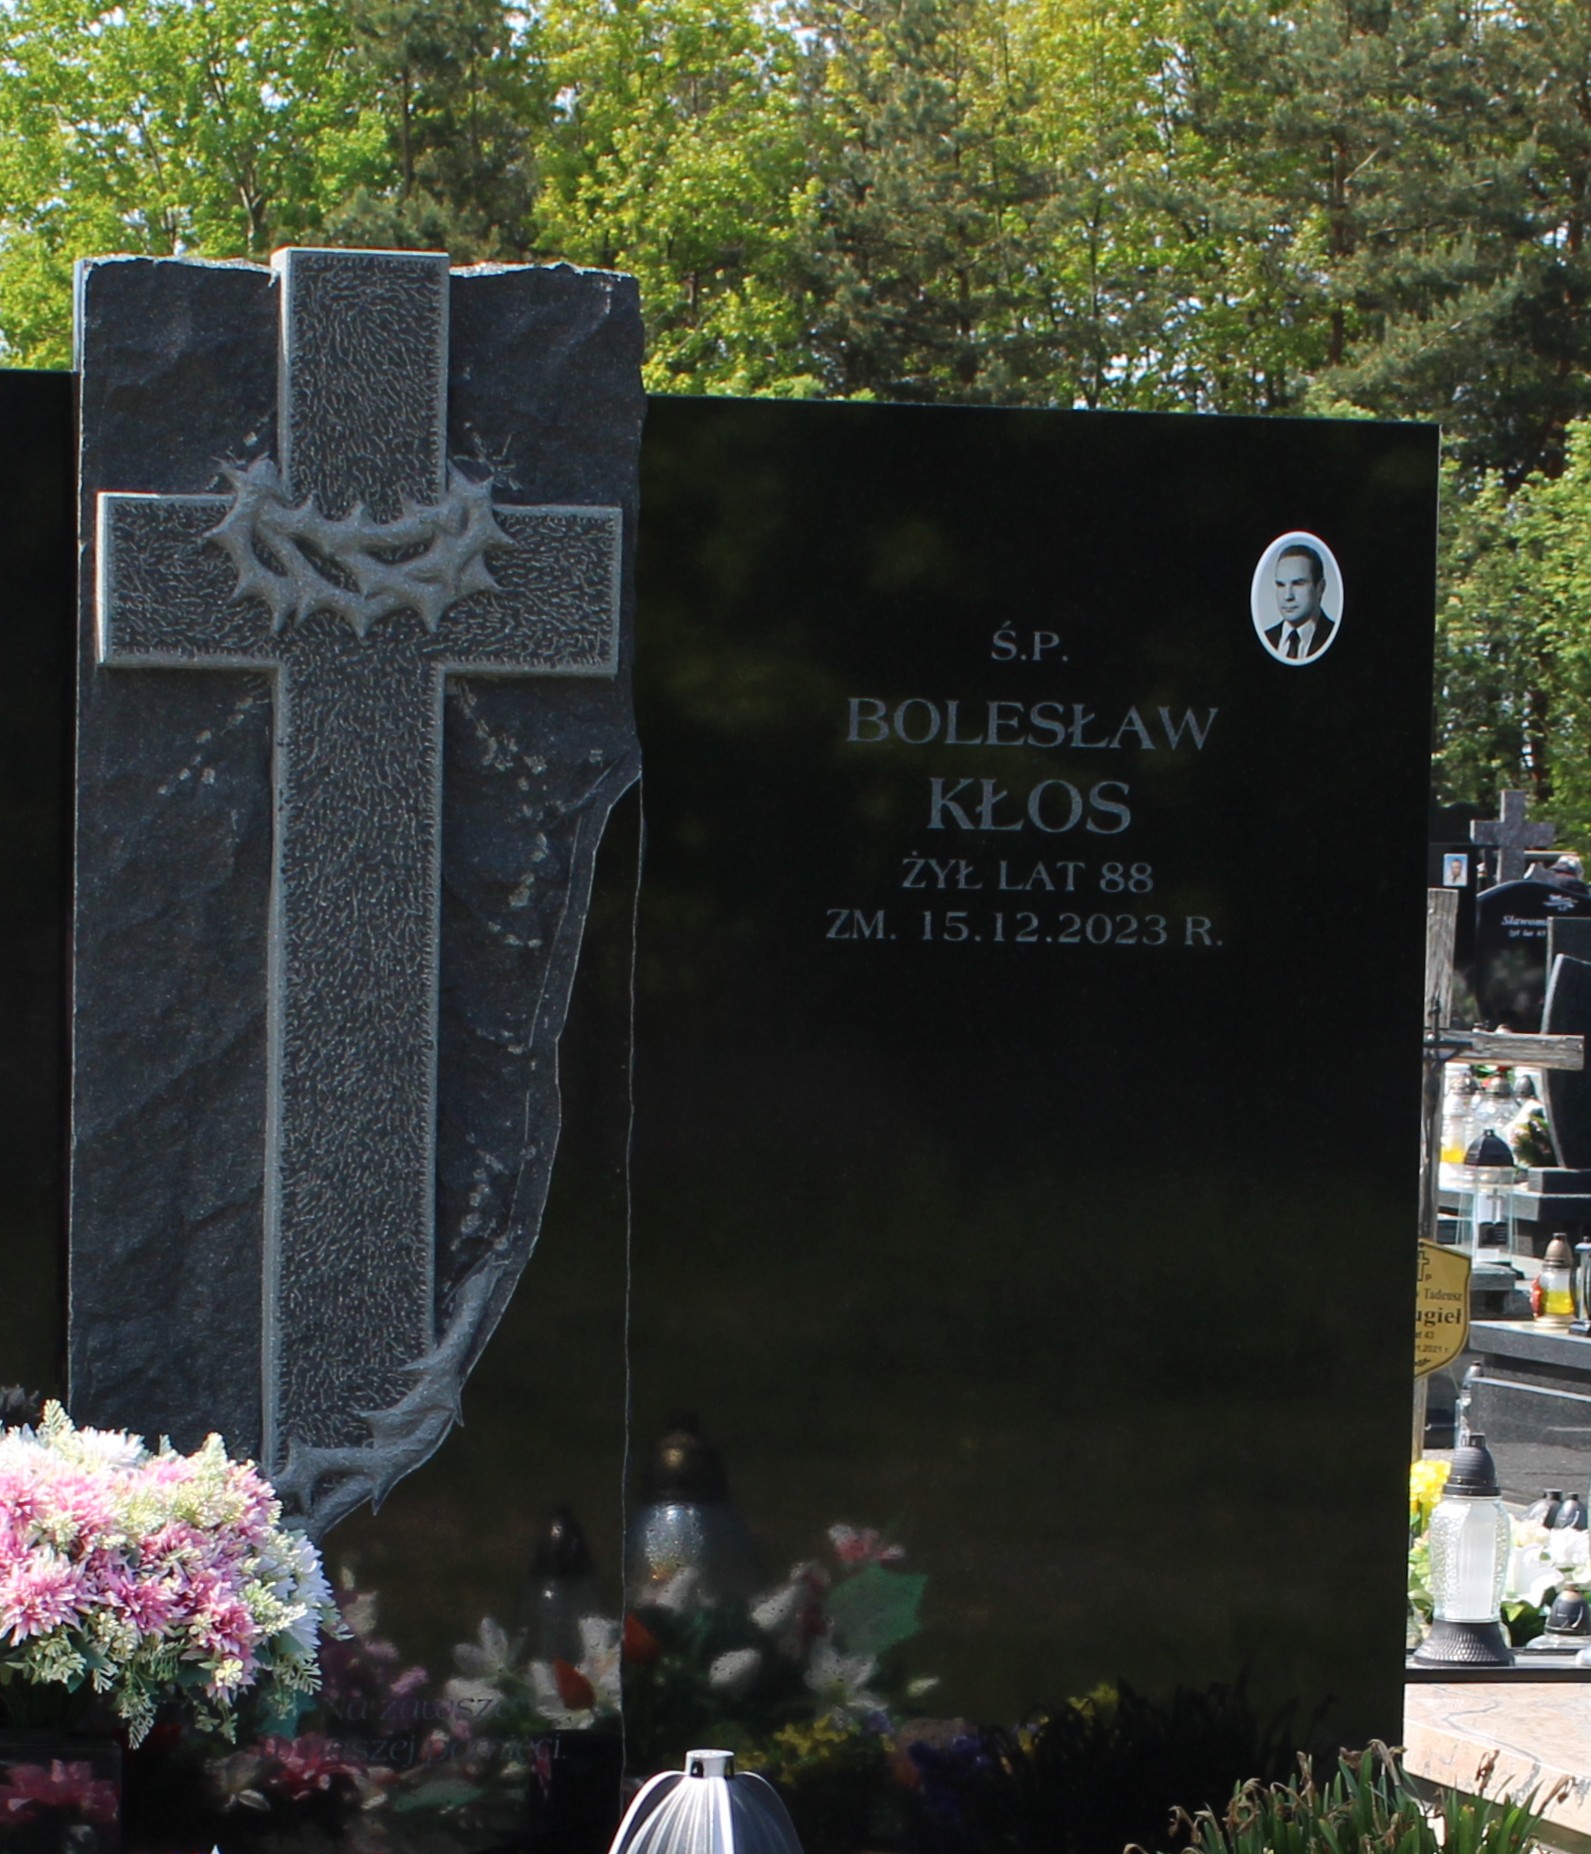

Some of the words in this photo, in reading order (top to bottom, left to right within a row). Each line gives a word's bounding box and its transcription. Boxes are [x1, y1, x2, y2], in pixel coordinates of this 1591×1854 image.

[989, 620, 1070, 663] Ś.P.
[845, 696, 1220, 752] BOLESŁAW
[926, 776, 1133, 835] KŁOS
[901, 850, 984, 890] ŻYŁ
[997, 860, 1087, 892] LAT
[1098, 861, 1155, 894] 88
[825, 908, 898, 941] ZM.
[921, 910, 1169, 946] 15.12.2023
[1182, 915, 1224, 947] R.
[1423, 1287, 1463, 1302] Tadeusz
